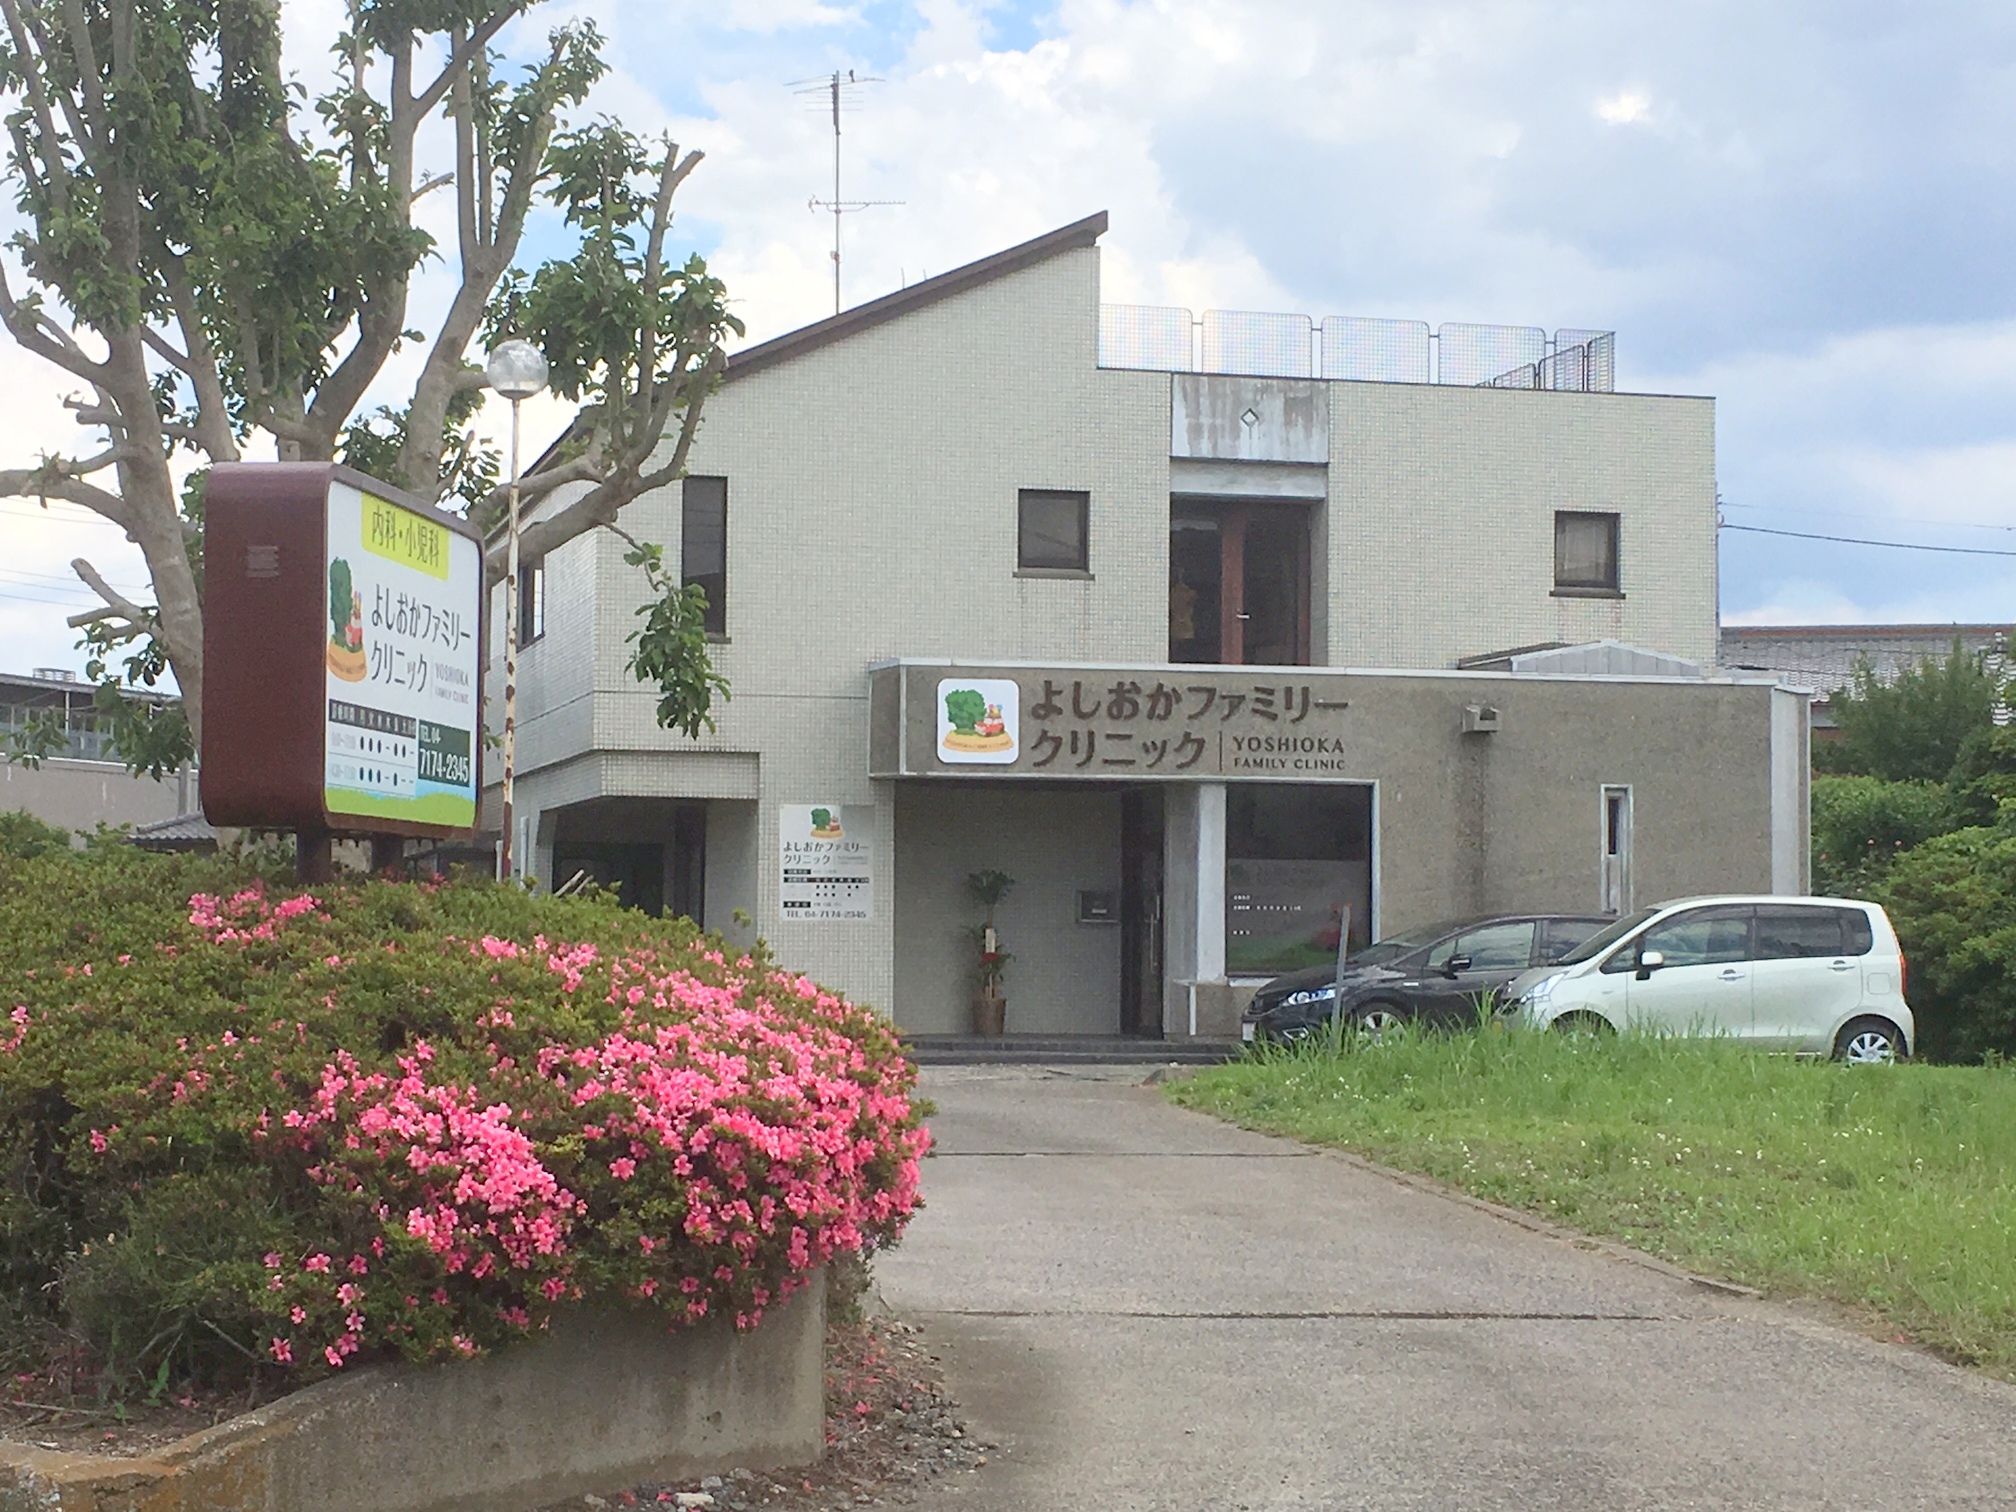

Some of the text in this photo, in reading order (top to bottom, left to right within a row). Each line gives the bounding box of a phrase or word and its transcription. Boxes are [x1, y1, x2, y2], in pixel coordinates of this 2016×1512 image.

[371, 505, 440, 568] 内科・小児科
[371, 584, 471, 651] よしおかファミリー
[371, 640, 428, 693] クリニック
[1031, 680, 1349, 724] よしおかファミリー
[1031, 729, 1206, 769] クリニック
[1232, 736, 1345, 754] YOSHIOKA
[1234, 757, 1346, 770] FAMILY CLINIC
[419, 748, 469, 783] 7174-2345
[783, 841, 870, 853] よしおかファミリー
[783, 853, 831, 866] クリニック
